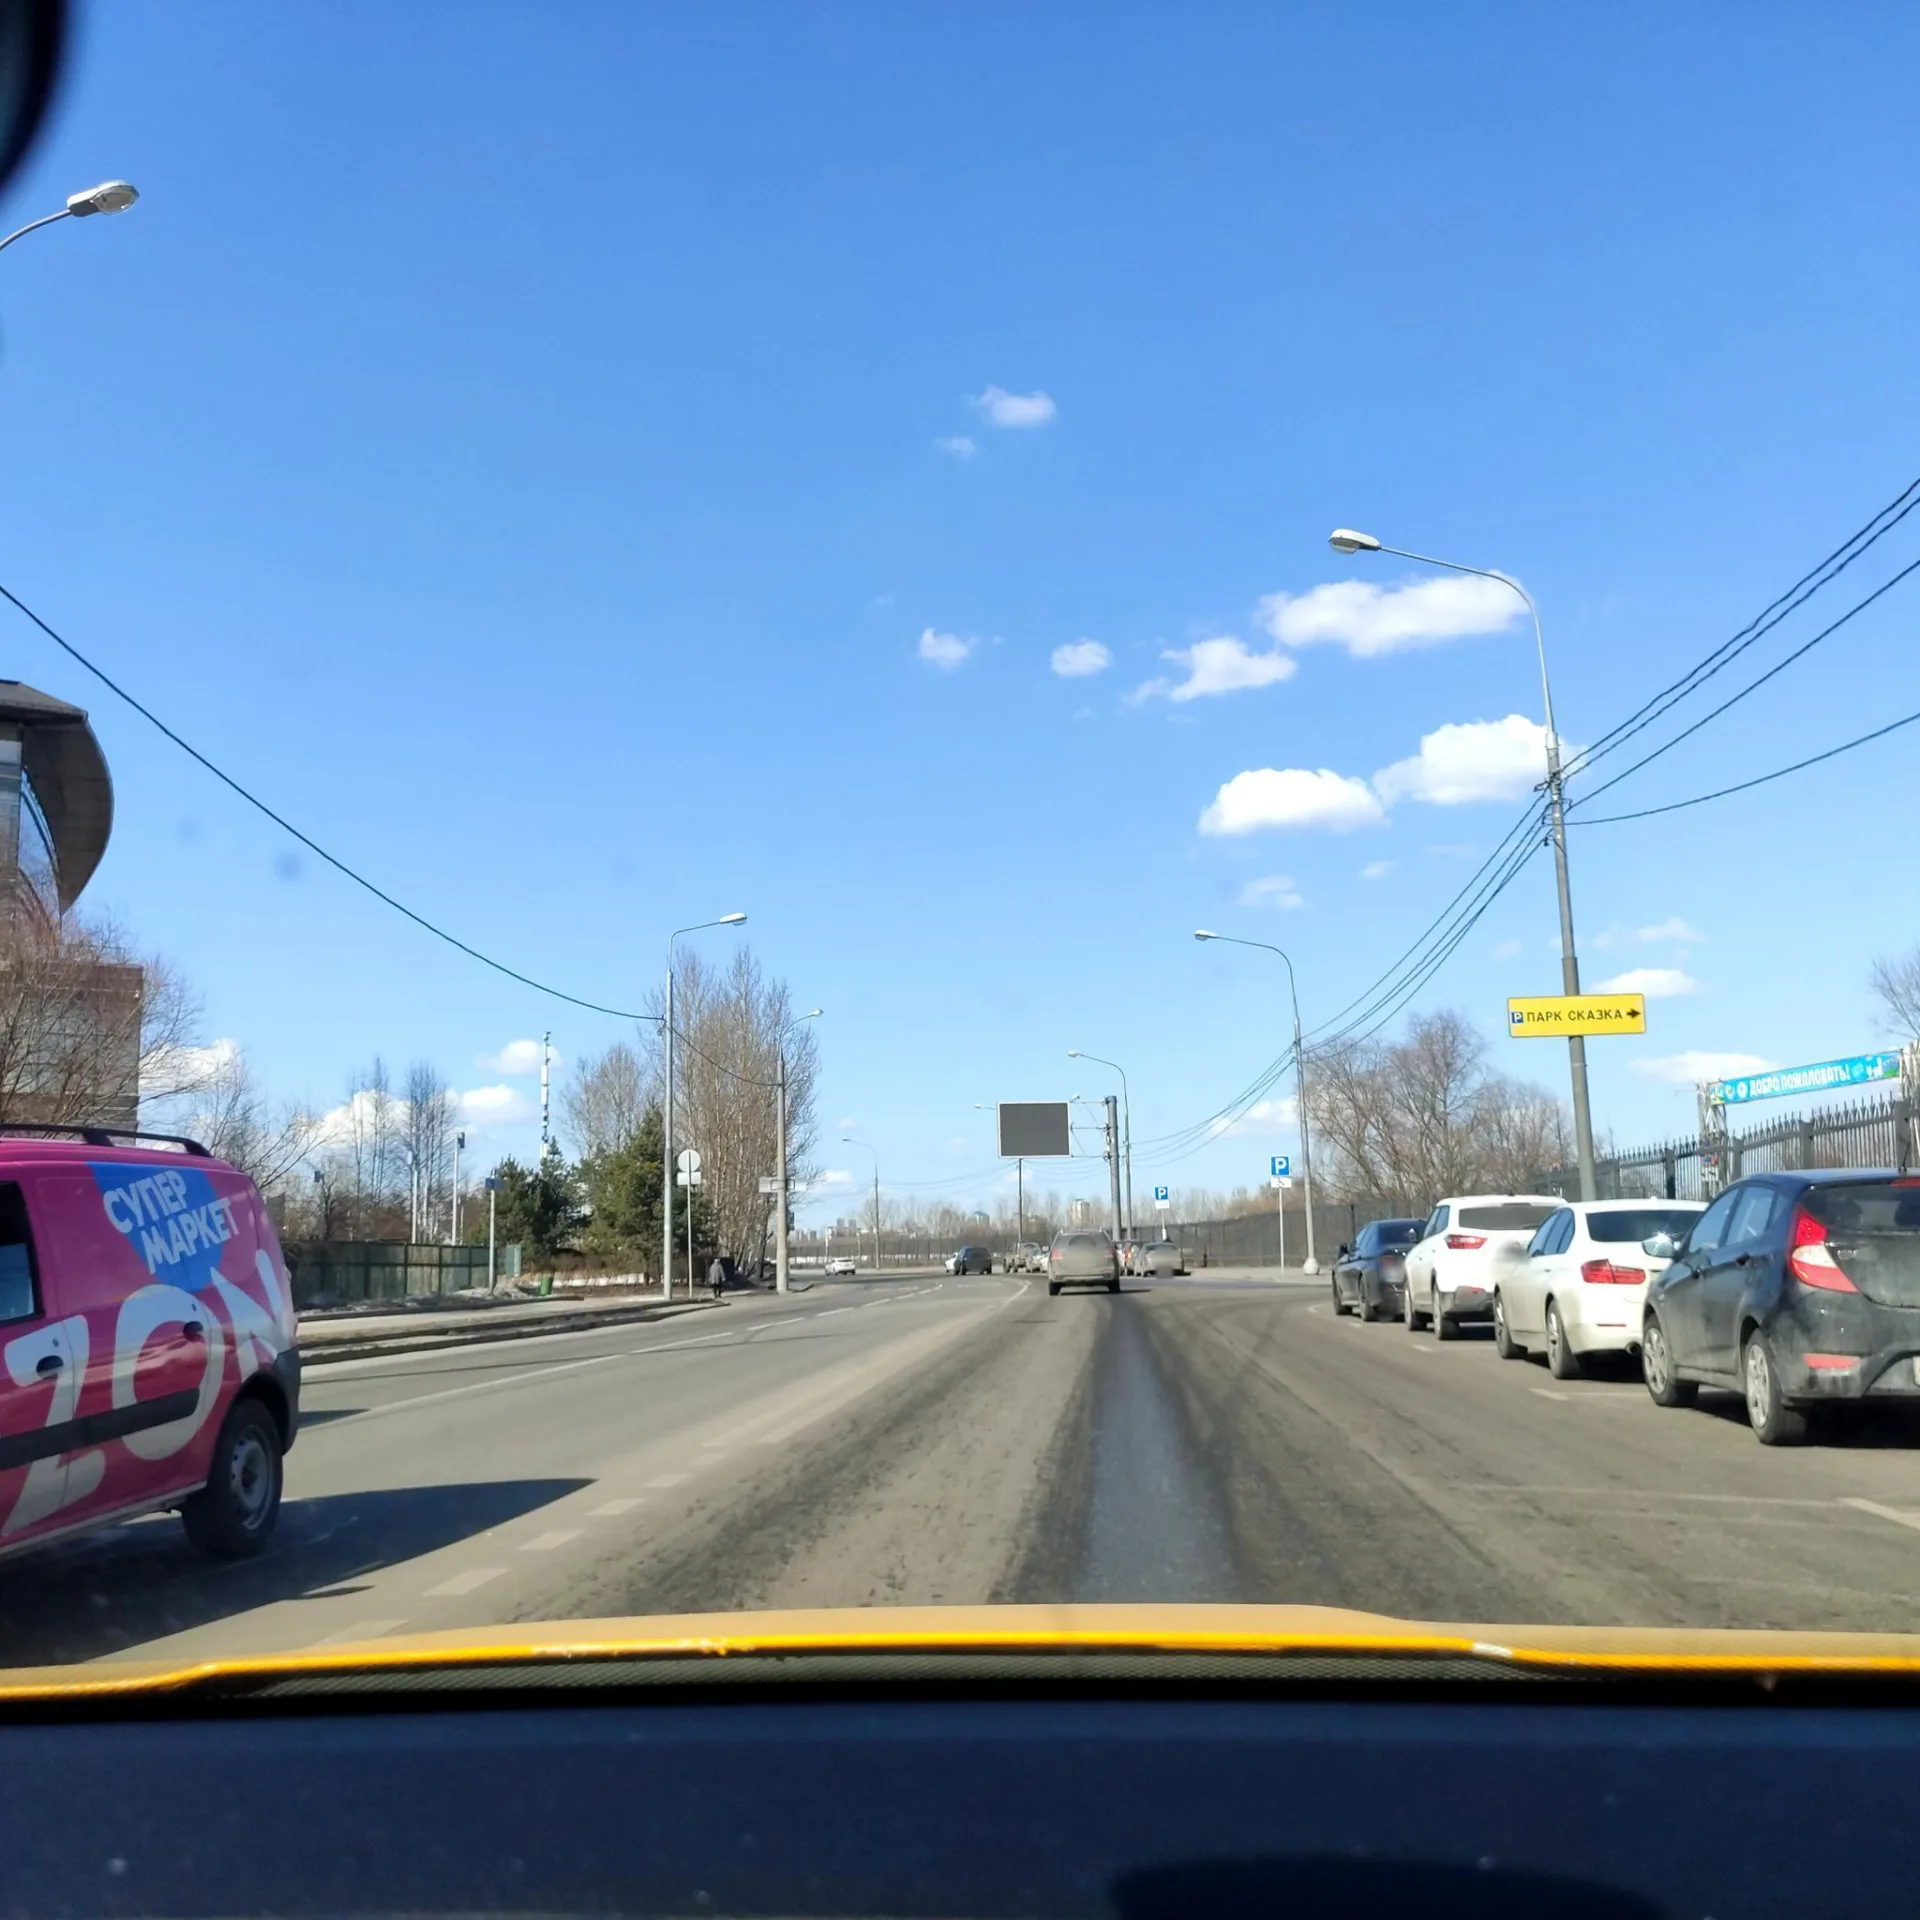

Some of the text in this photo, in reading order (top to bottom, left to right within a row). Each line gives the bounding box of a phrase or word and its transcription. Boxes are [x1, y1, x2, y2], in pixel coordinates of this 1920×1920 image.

[1527, 1011, 1563, 1022] ПАРК
[1568, 1009, 1623, 1021] СКАЗКА
[1749, 1063, 1850, 1098] ДОБРО ПОЖАЛОВАТЬ!
[1275, 1157, 1287, 1174] P
[103, 1169, 188, 1235] СУПЕР
[141, 1196, 239, 1275] МАРКЕТ
